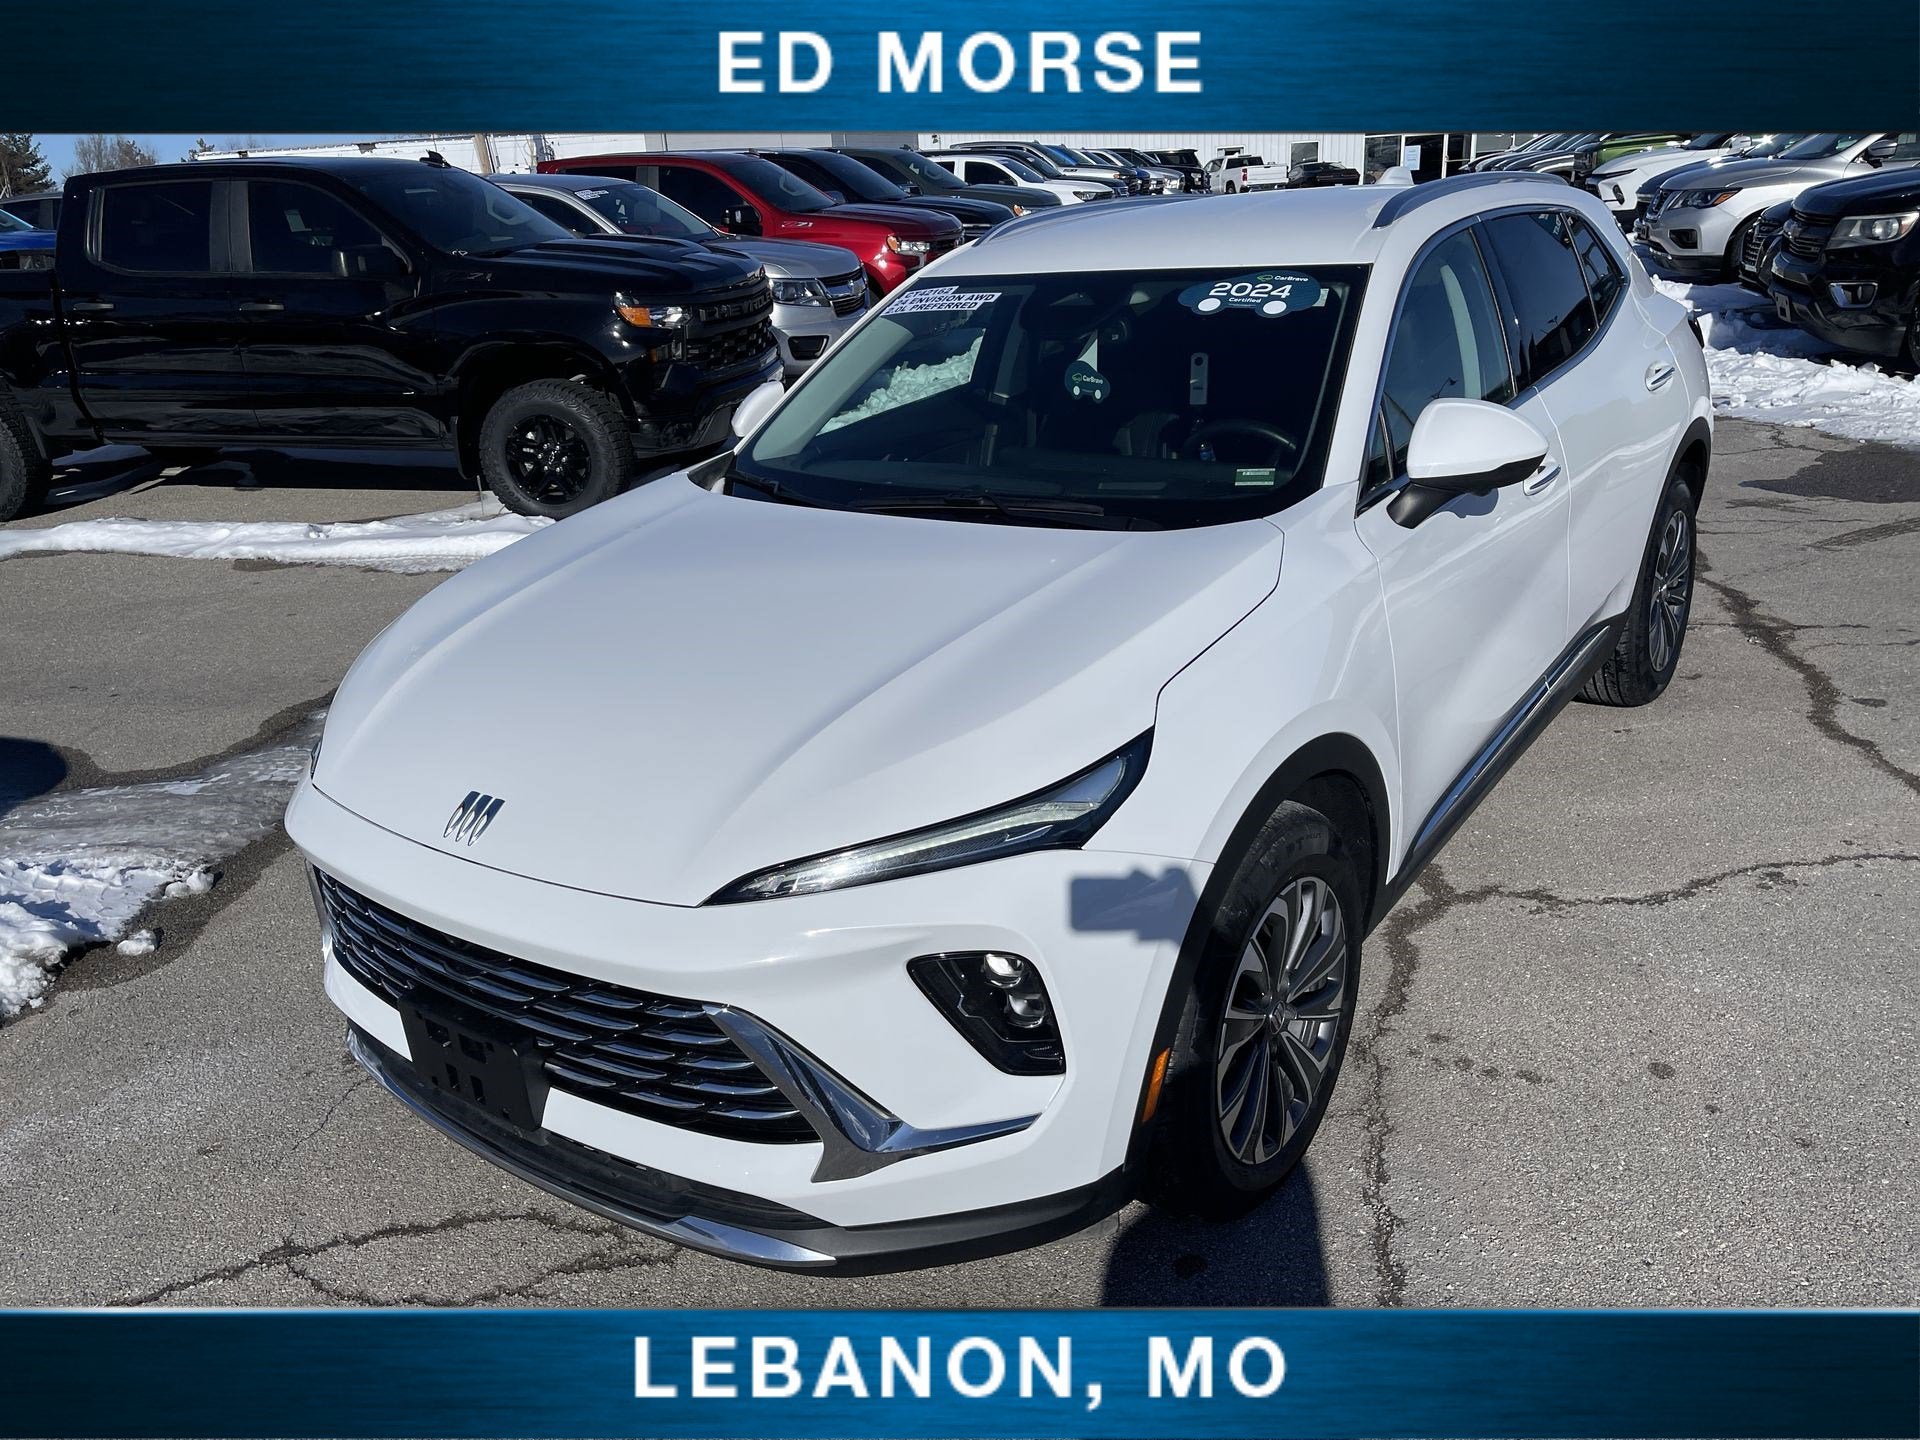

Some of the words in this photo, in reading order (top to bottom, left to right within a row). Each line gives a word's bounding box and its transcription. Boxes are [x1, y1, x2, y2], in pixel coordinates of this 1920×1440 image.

[1208, 282, 1293, 298] 2024
[909, 294, 965, 305] ENVISION
[965, 293, 995, 301] AWD
[909, 301, 978, 311] PREFERRED
